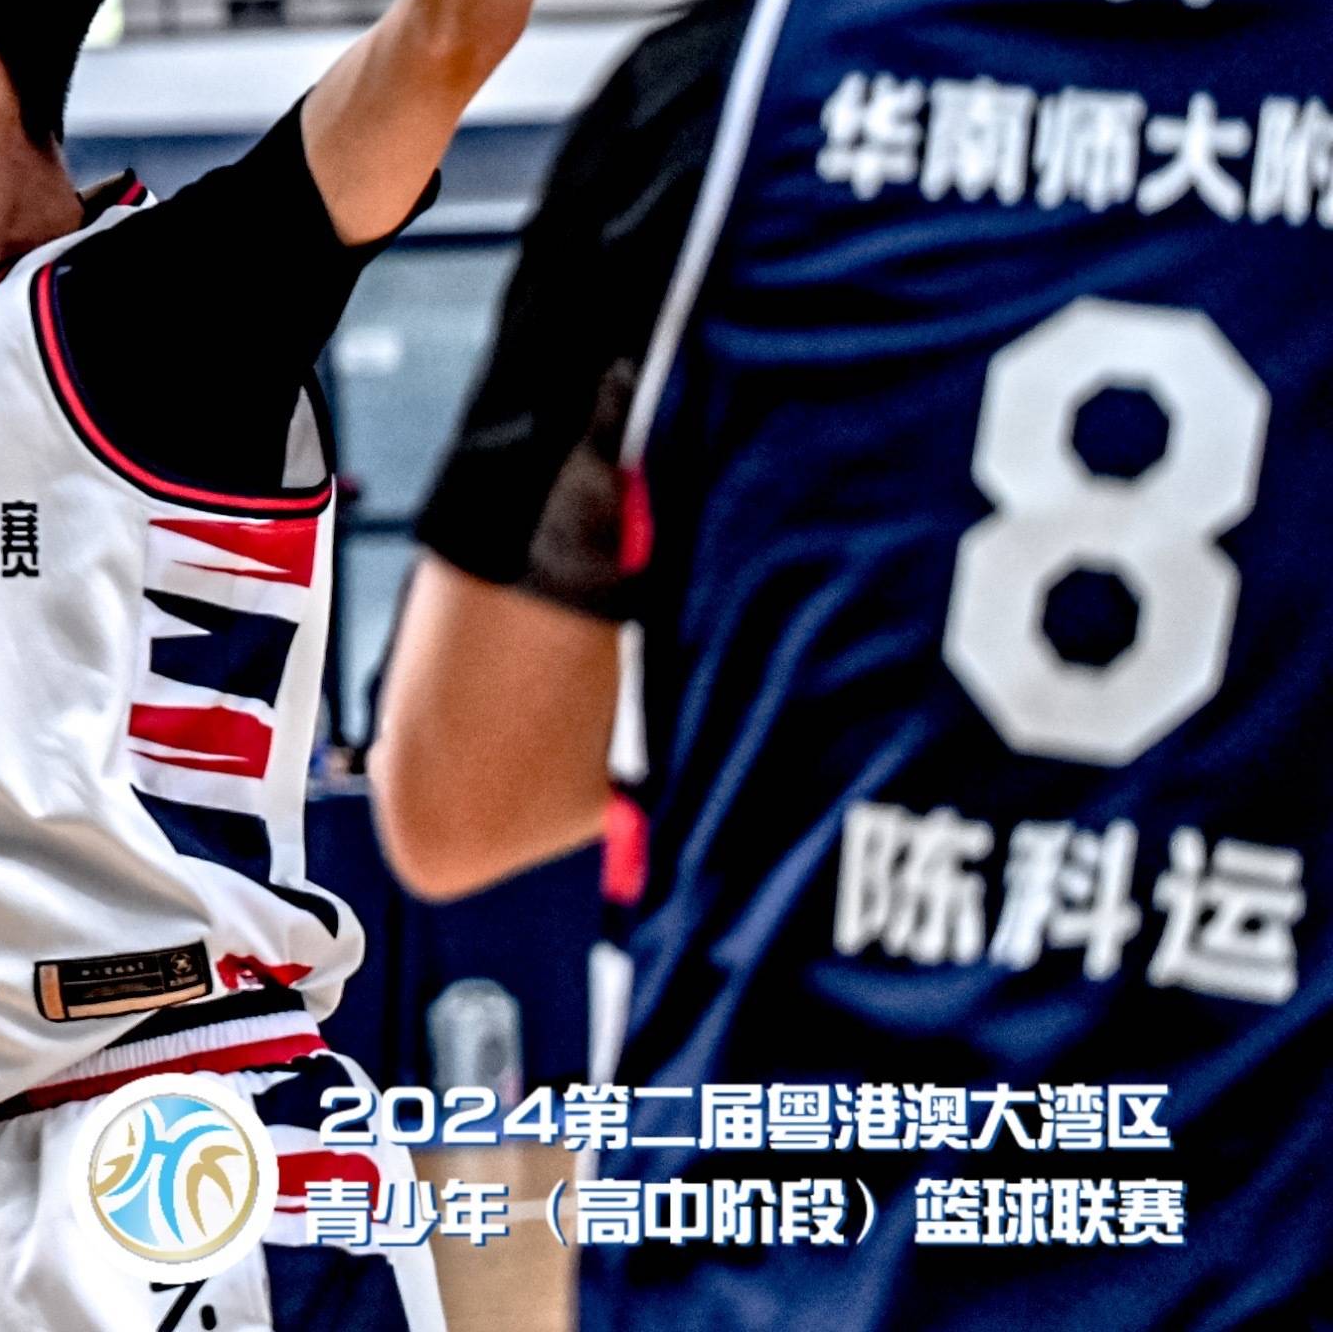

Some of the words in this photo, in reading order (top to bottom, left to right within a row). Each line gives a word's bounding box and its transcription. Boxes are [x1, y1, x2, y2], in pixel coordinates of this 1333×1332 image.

[941, 293, 1272, 768] 8
[834, 800, 1307, 1005] 陈科运
